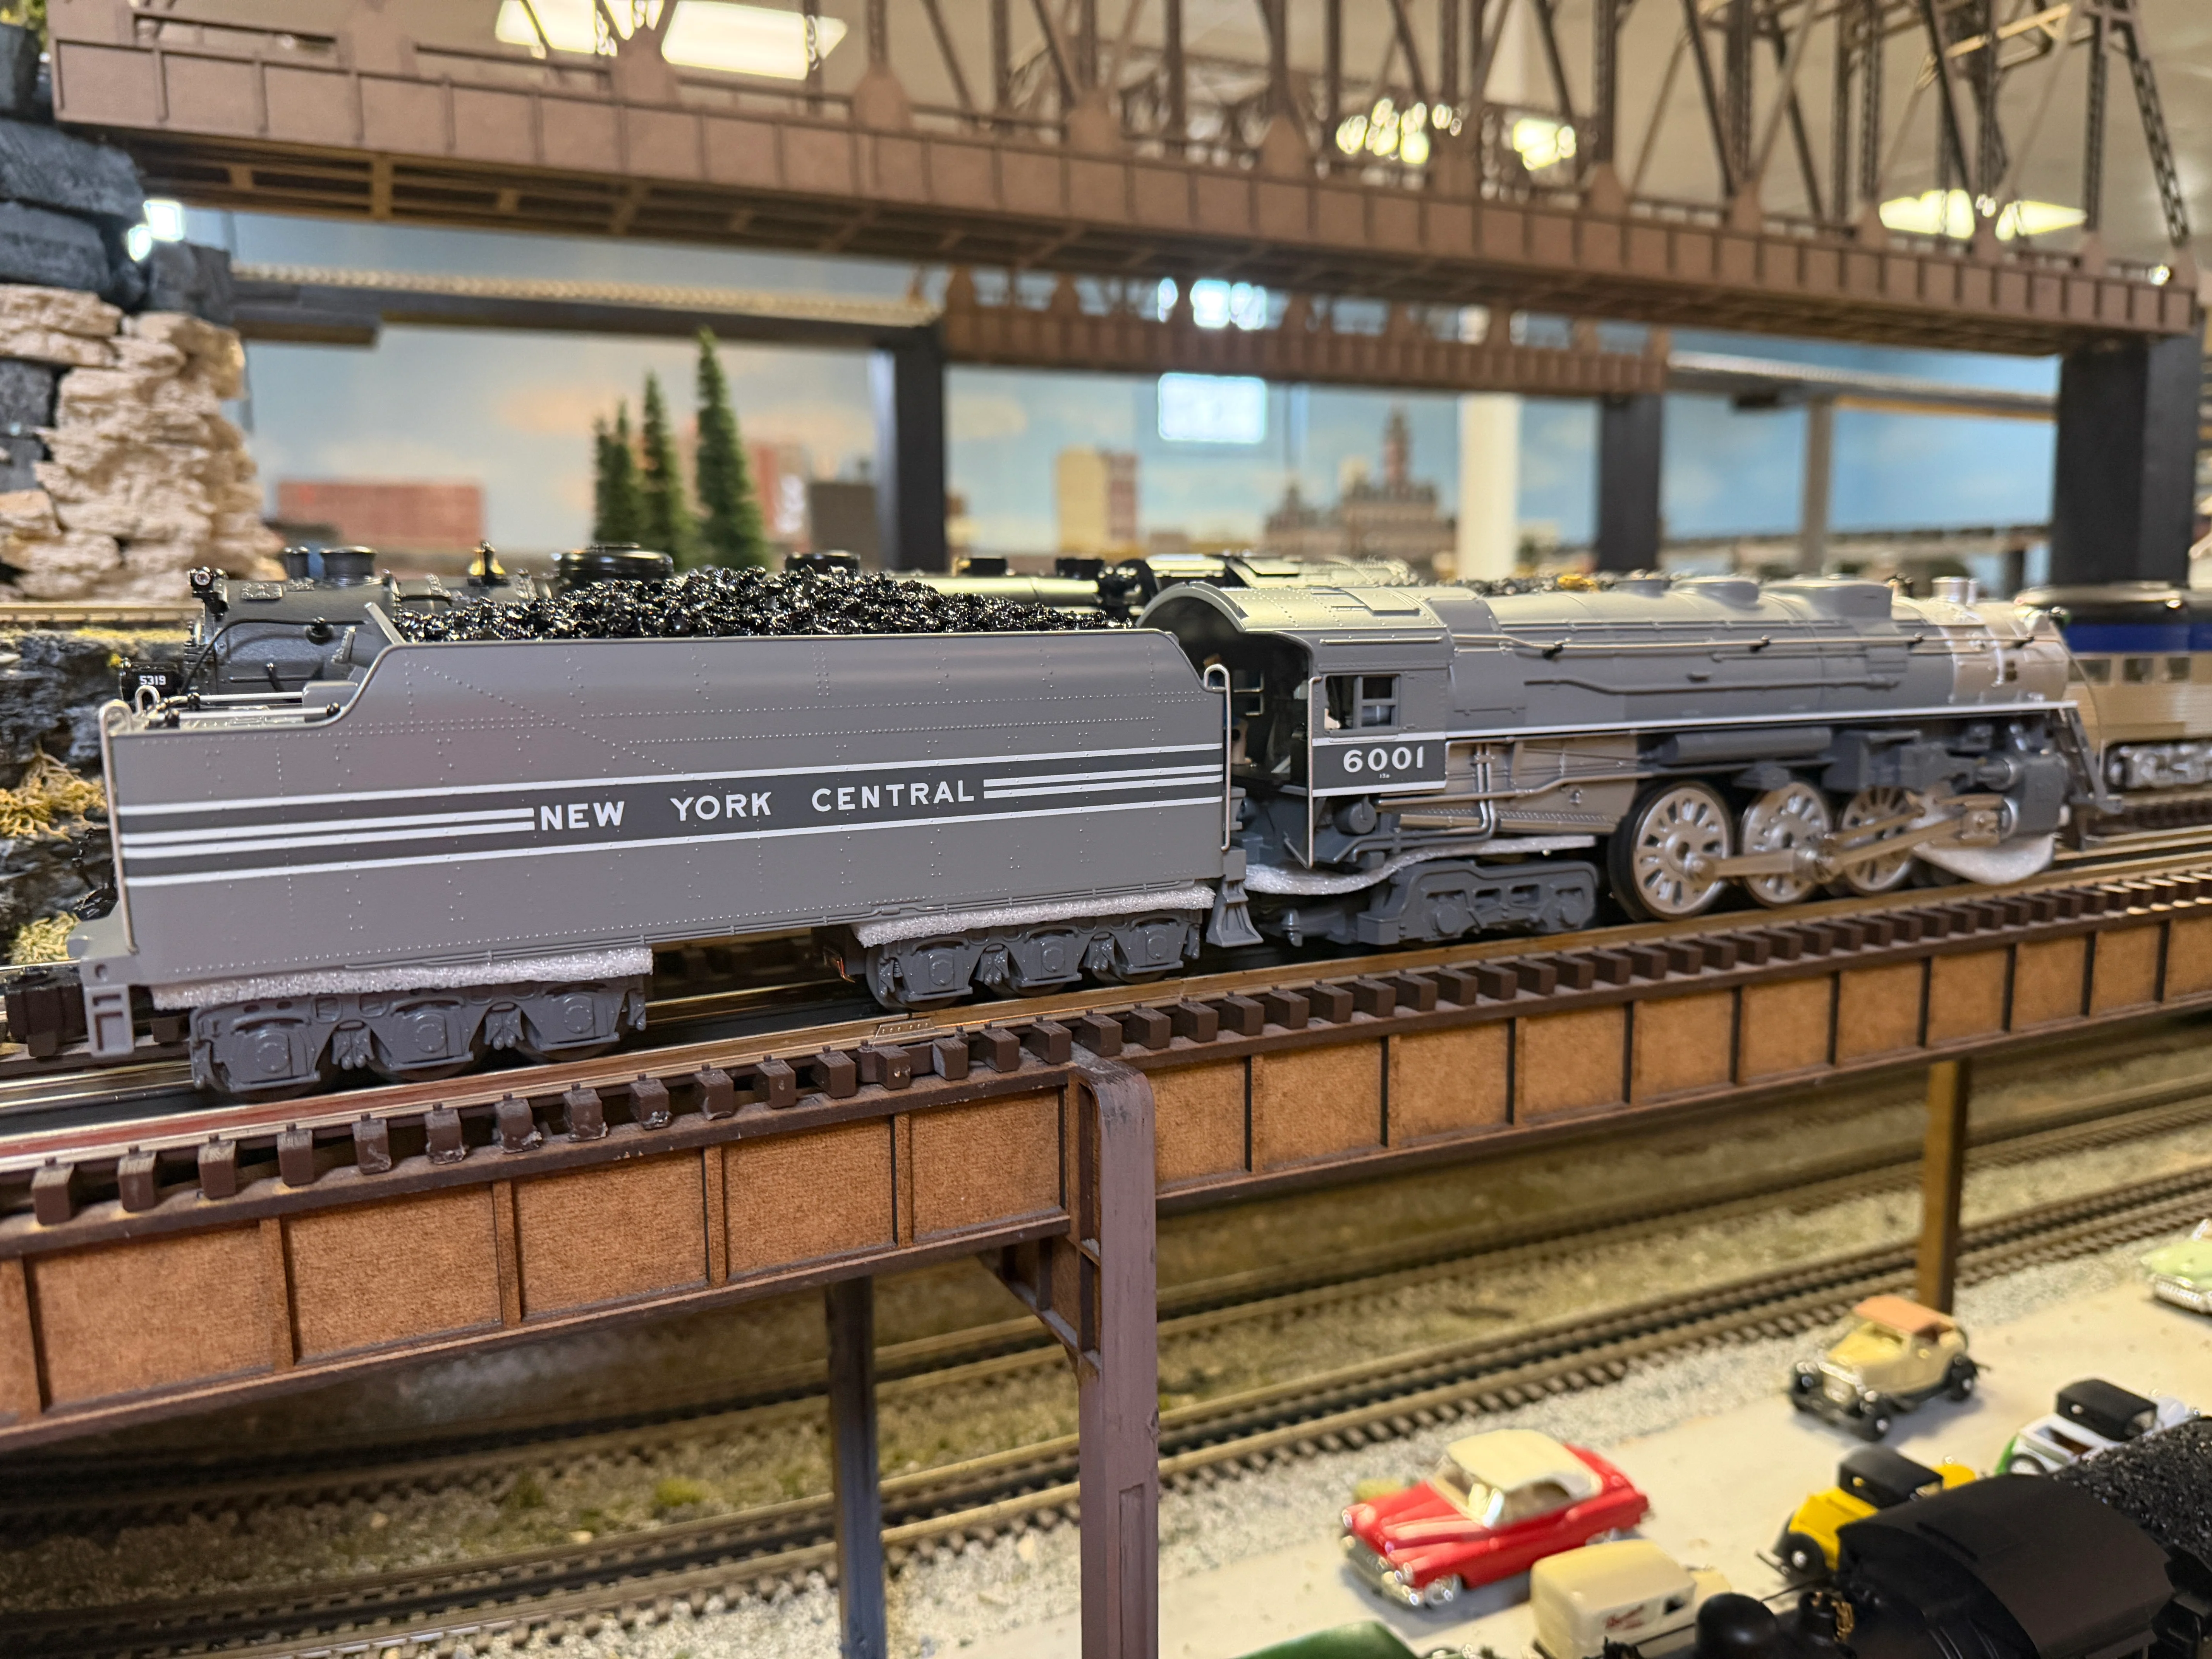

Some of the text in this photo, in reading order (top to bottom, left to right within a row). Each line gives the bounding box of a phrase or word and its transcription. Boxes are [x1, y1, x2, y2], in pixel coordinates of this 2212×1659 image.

[139, 675, 167, 685] 5319
[1343, 746, 1424, 773] 6001
[540, 780, 975, 831] NEW YORK CENTRAL
